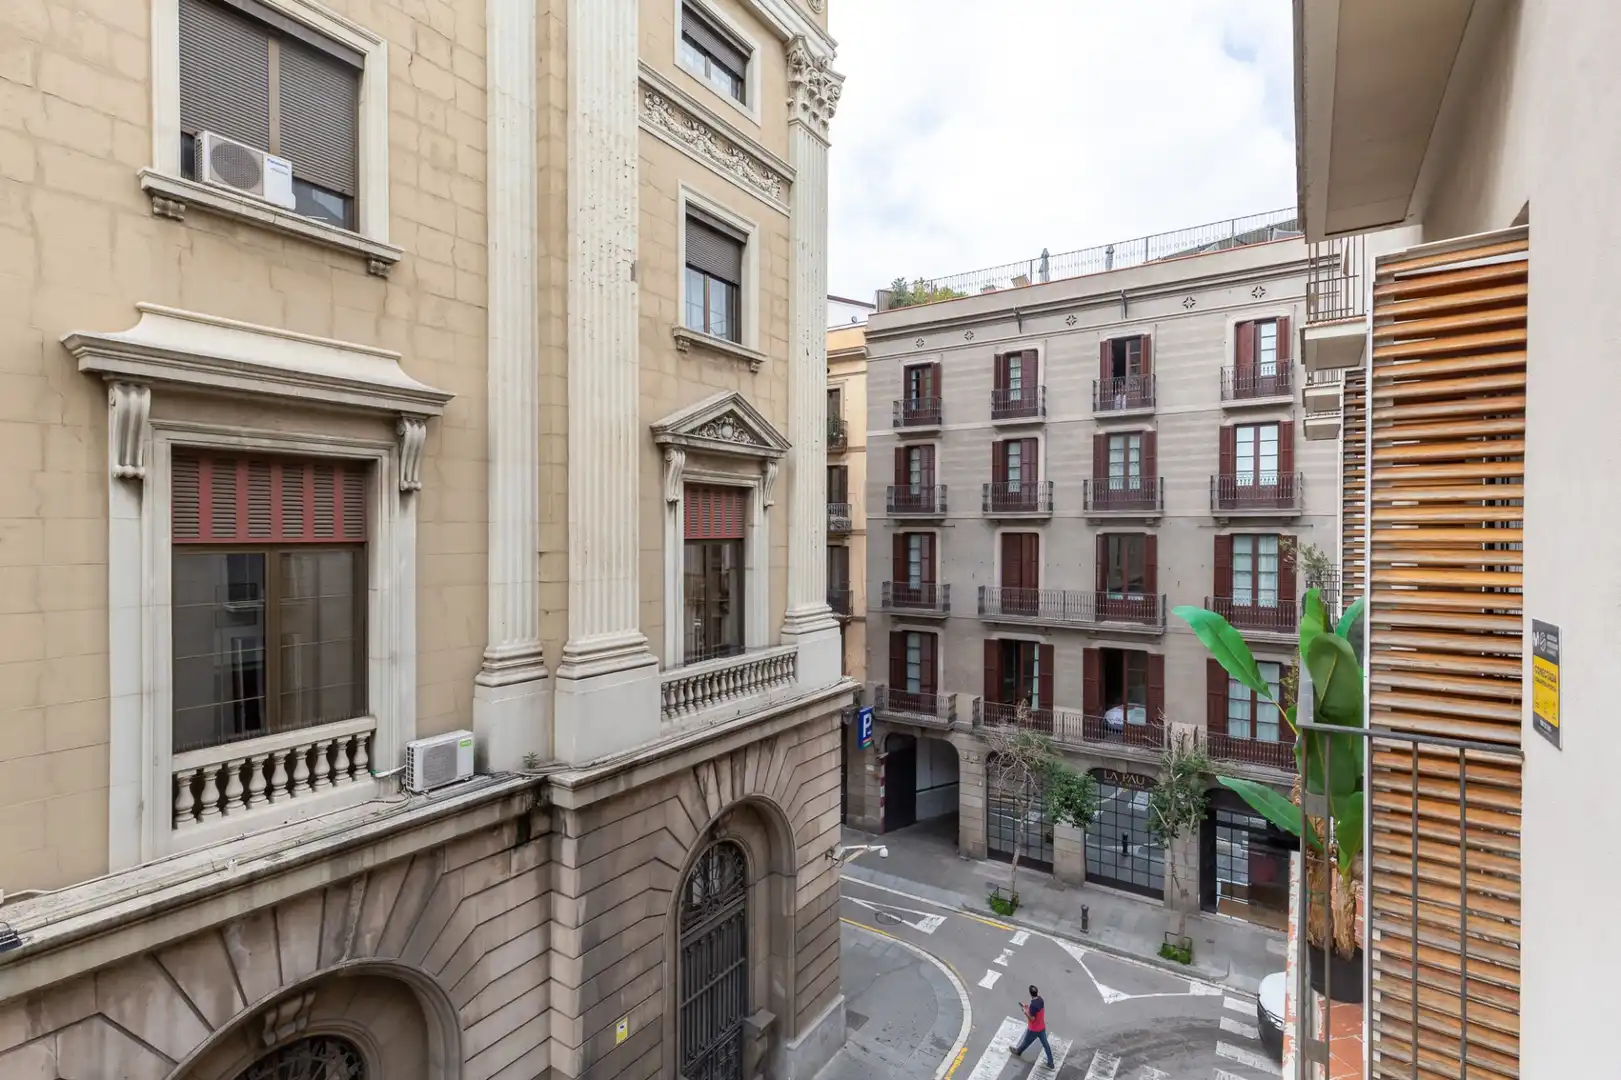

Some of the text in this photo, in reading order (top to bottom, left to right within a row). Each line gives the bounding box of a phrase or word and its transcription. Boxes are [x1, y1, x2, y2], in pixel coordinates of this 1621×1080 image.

[863, 713, 872, 738] P
[1104, 770, 1119, 781] LA
[1122, 773, 1145, 785] PAU
